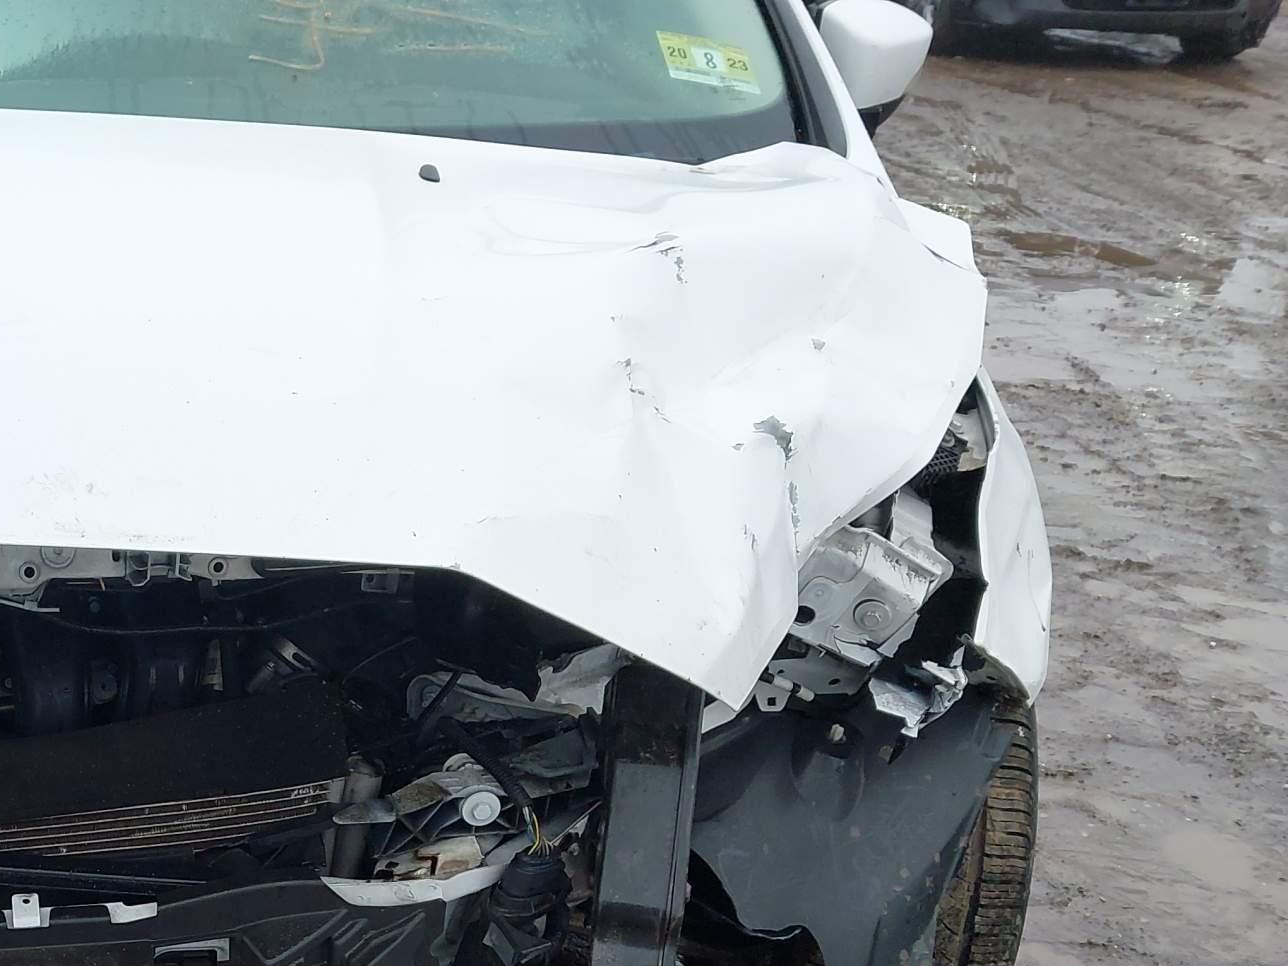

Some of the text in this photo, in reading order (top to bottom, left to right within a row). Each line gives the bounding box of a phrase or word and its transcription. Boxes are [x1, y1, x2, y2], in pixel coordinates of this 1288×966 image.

[667, 46, 688, 59] 20
[703, 52, 718, 69] 8
[727, 58, 749, 72] 23
